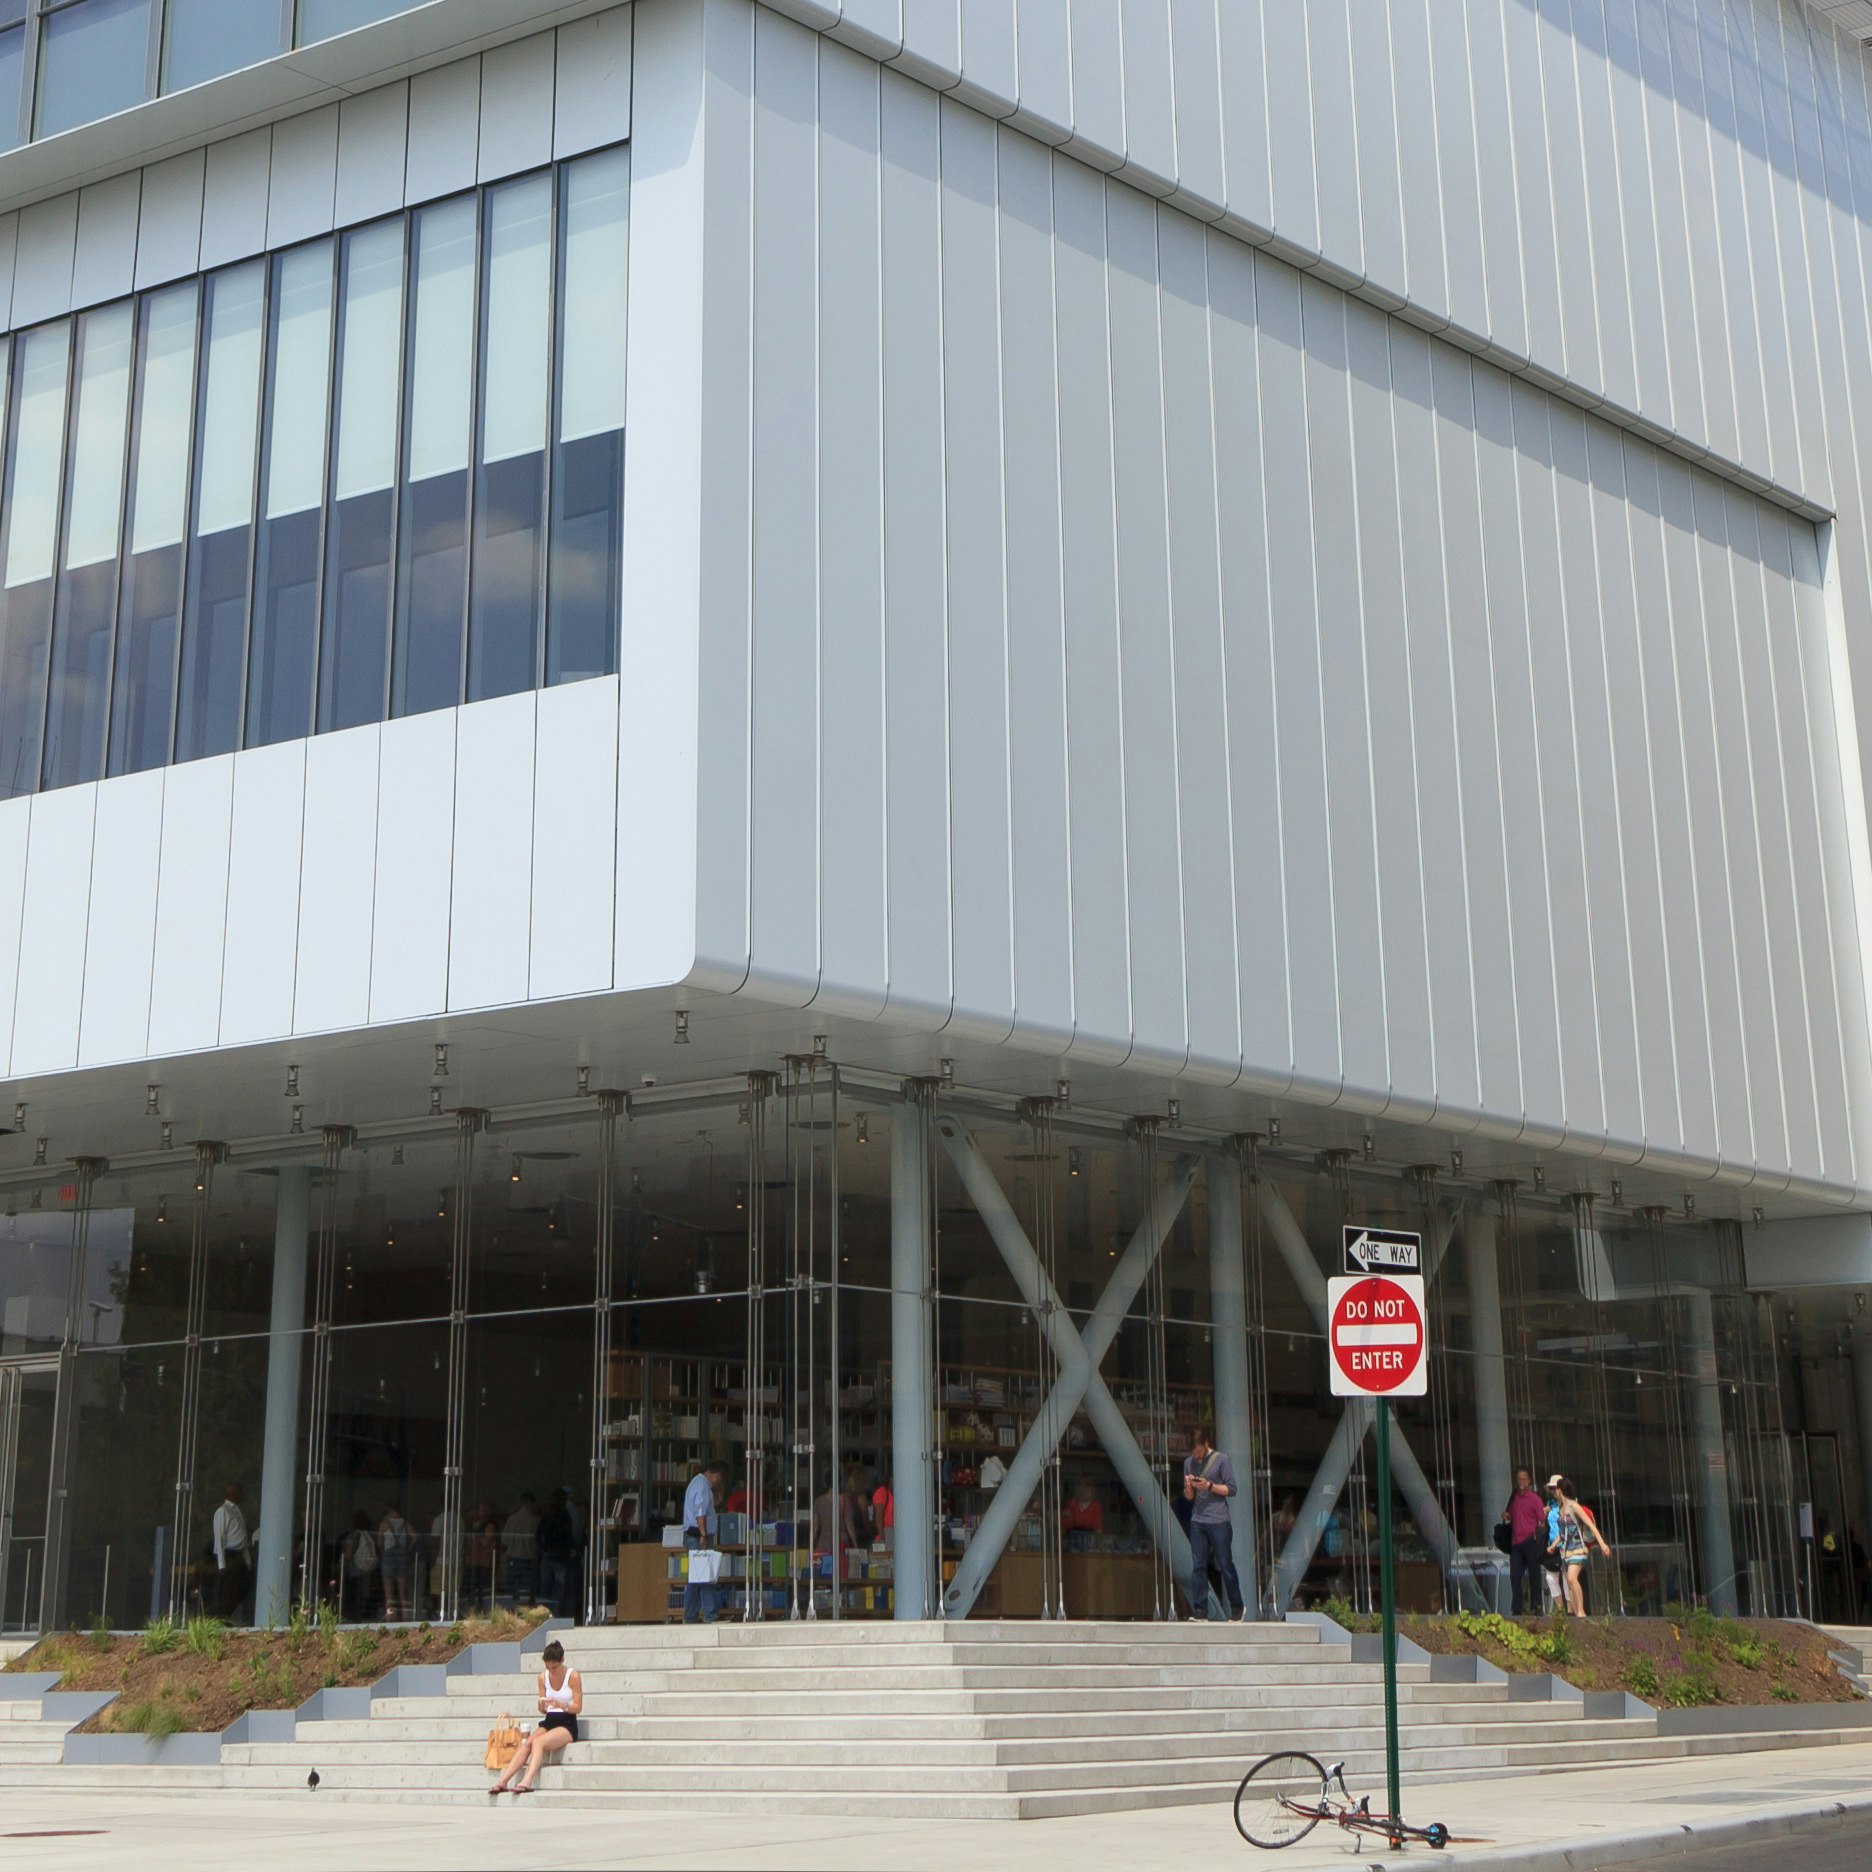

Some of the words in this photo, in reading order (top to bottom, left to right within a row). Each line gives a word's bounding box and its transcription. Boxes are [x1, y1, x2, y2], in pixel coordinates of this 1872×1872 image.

[1359, 1242, 1380, 1261] ONE
[1390, 1245, 1413, 1264] WAY
[1346, 1300, 1368, 1319] DO
[1374, 1299, 1405, 1318] NOT
[1351, 1350, 1404, 1371] ENTER
